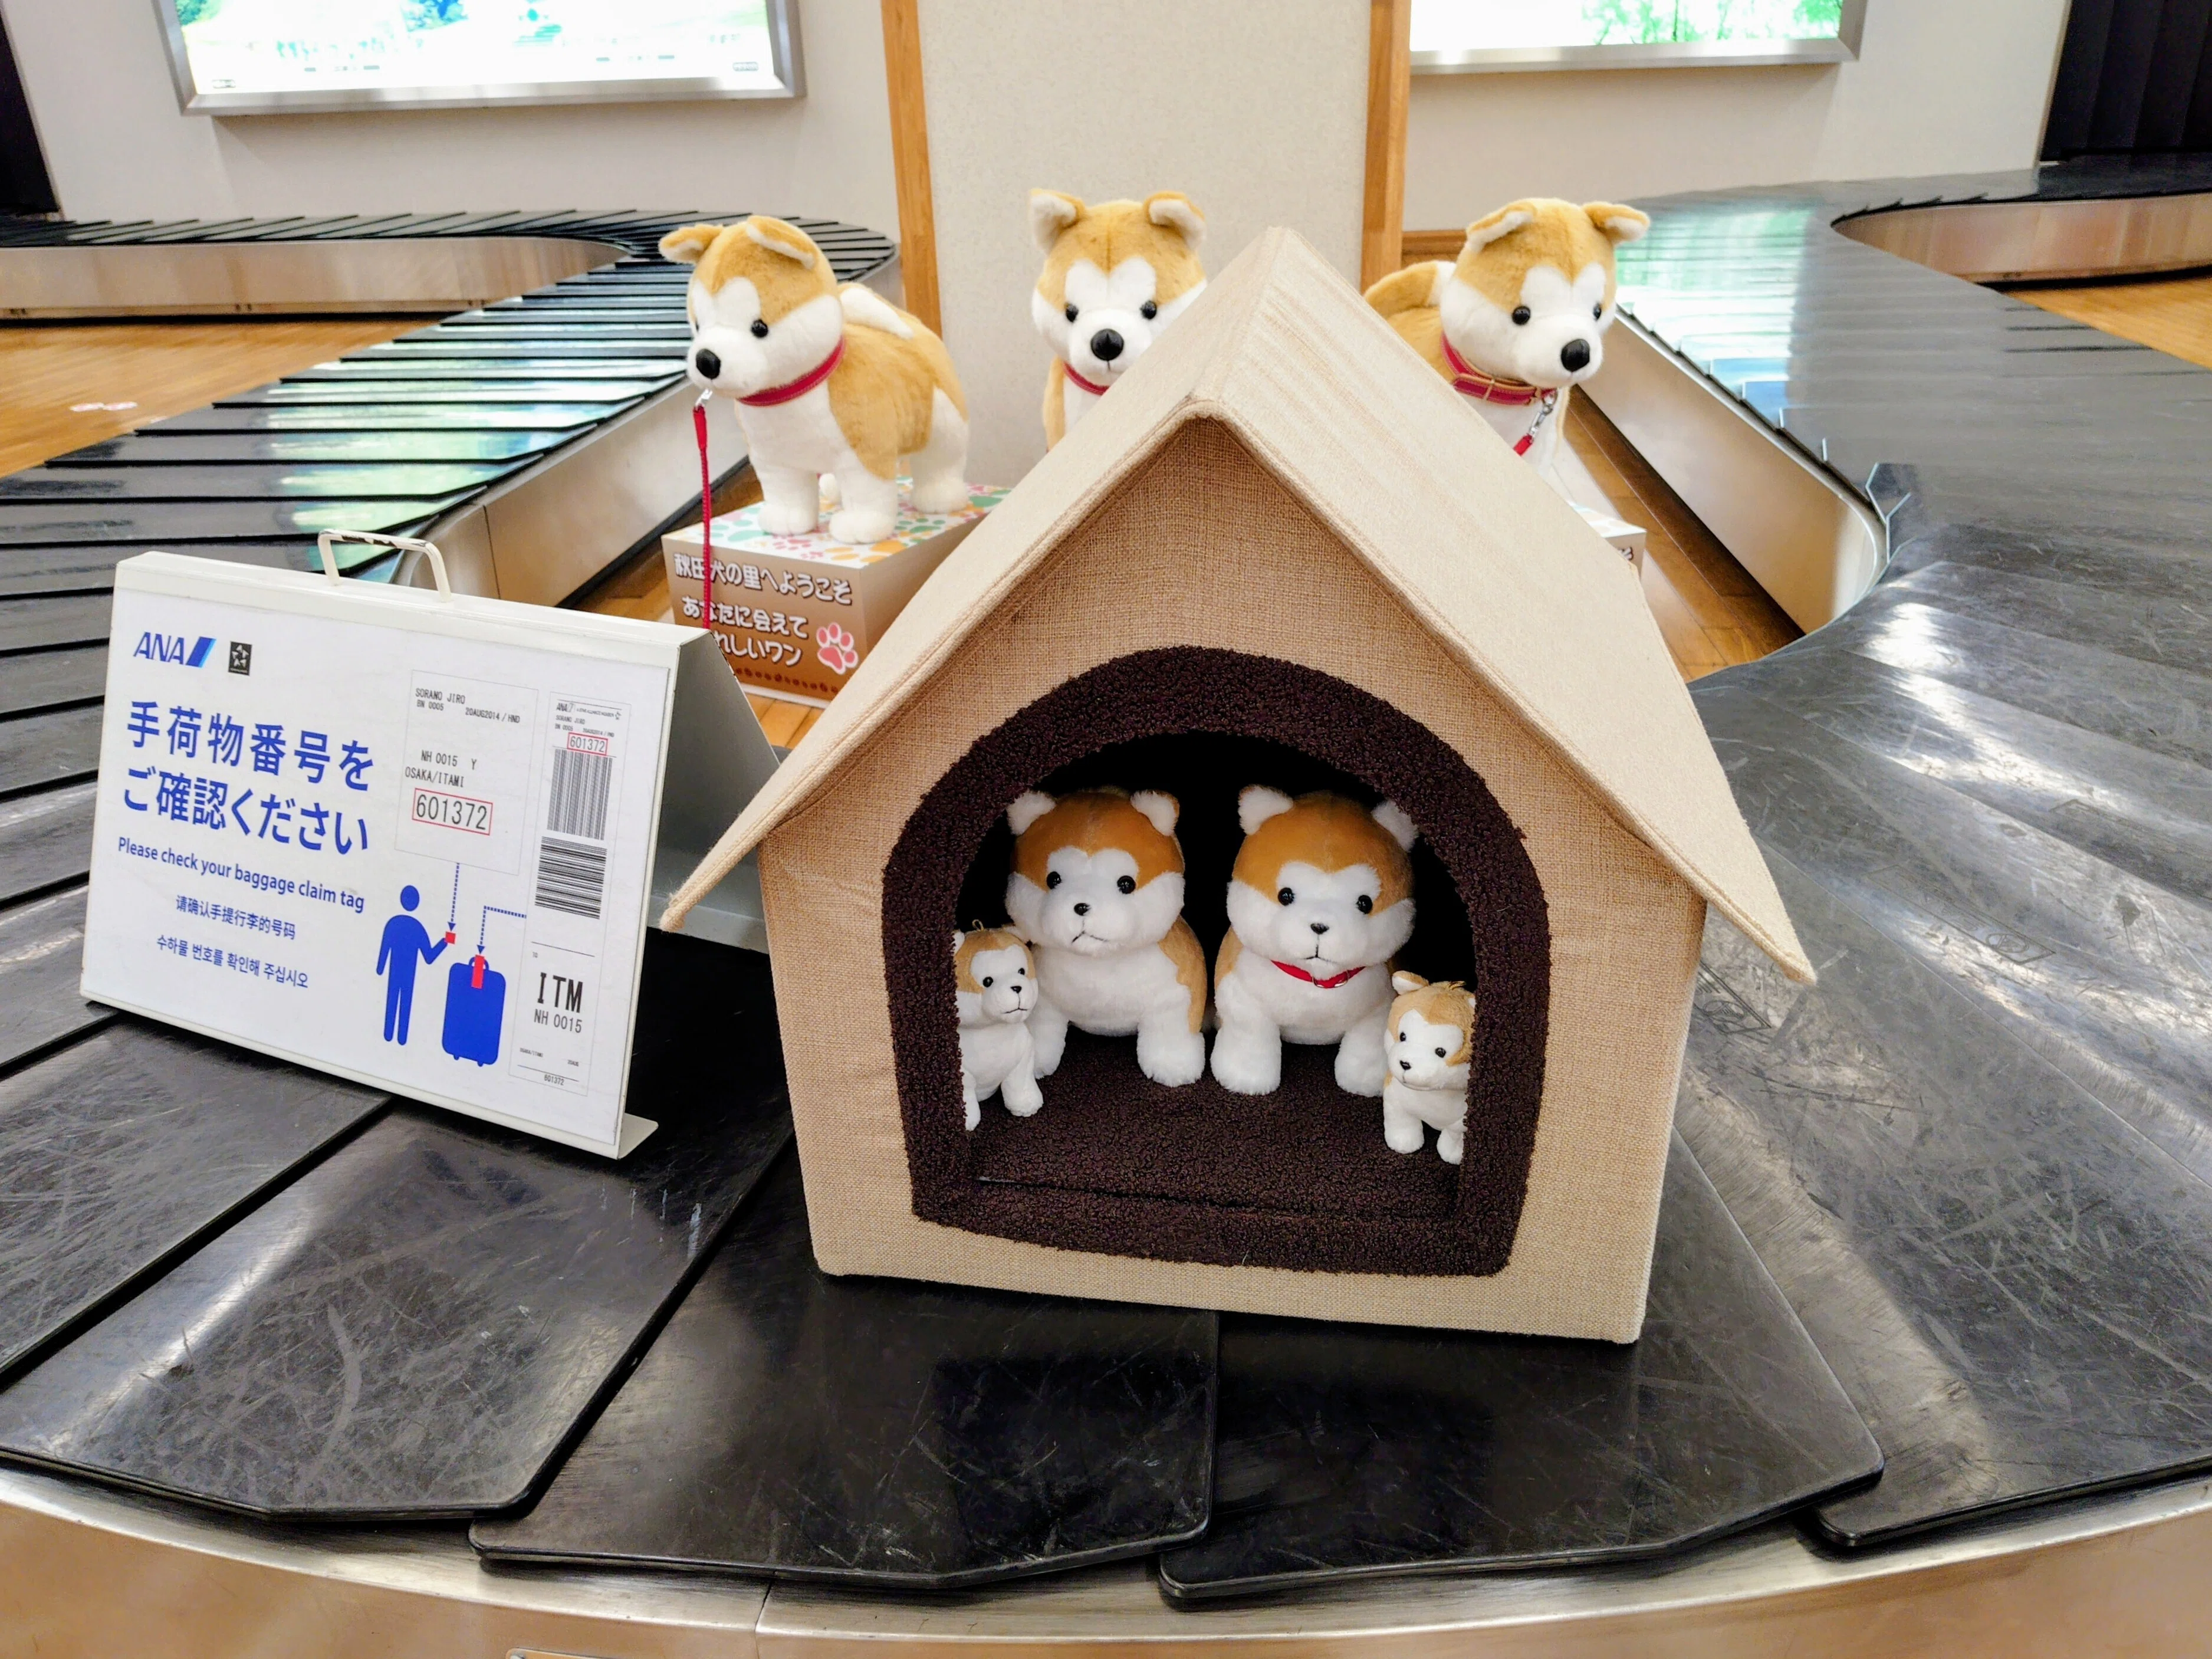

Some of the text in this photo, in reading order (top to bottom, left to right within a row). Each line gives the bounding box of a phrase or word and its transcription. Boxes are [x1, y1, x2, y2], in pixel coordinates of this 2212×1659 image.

[133, 631, 185, 665] ANA
[415, 688, 465, 704] SORANO JIRO
[429, 702, 444, 711] 0005
[465, 707, 500, 721] 20AUG2014
[508, 715, 520, 724] HND
[127, 700, 374, 791] 手荷物番号を
[421, 749, 477, 770] NH 0015 Y
[570, 735, 605, 753] 601372
[405, 766, 464, 788] OSAKA/ITAMI
[123, 766, 369, 855] ご確認ください
[416, 794, 487, 830] 601372
[119, 837, 364, 913] Please check your baggage claim tag
[176, 895, 295, 940] 请确认手提行李的号码
[156, 934, 308, 988] 수하물 번호를 확인해 주십시오
[537, 971, 583, 1013] ITM
[534, 1008, 583, 1033] NH 0015
[544, 1074, 564, 1086] 601372
